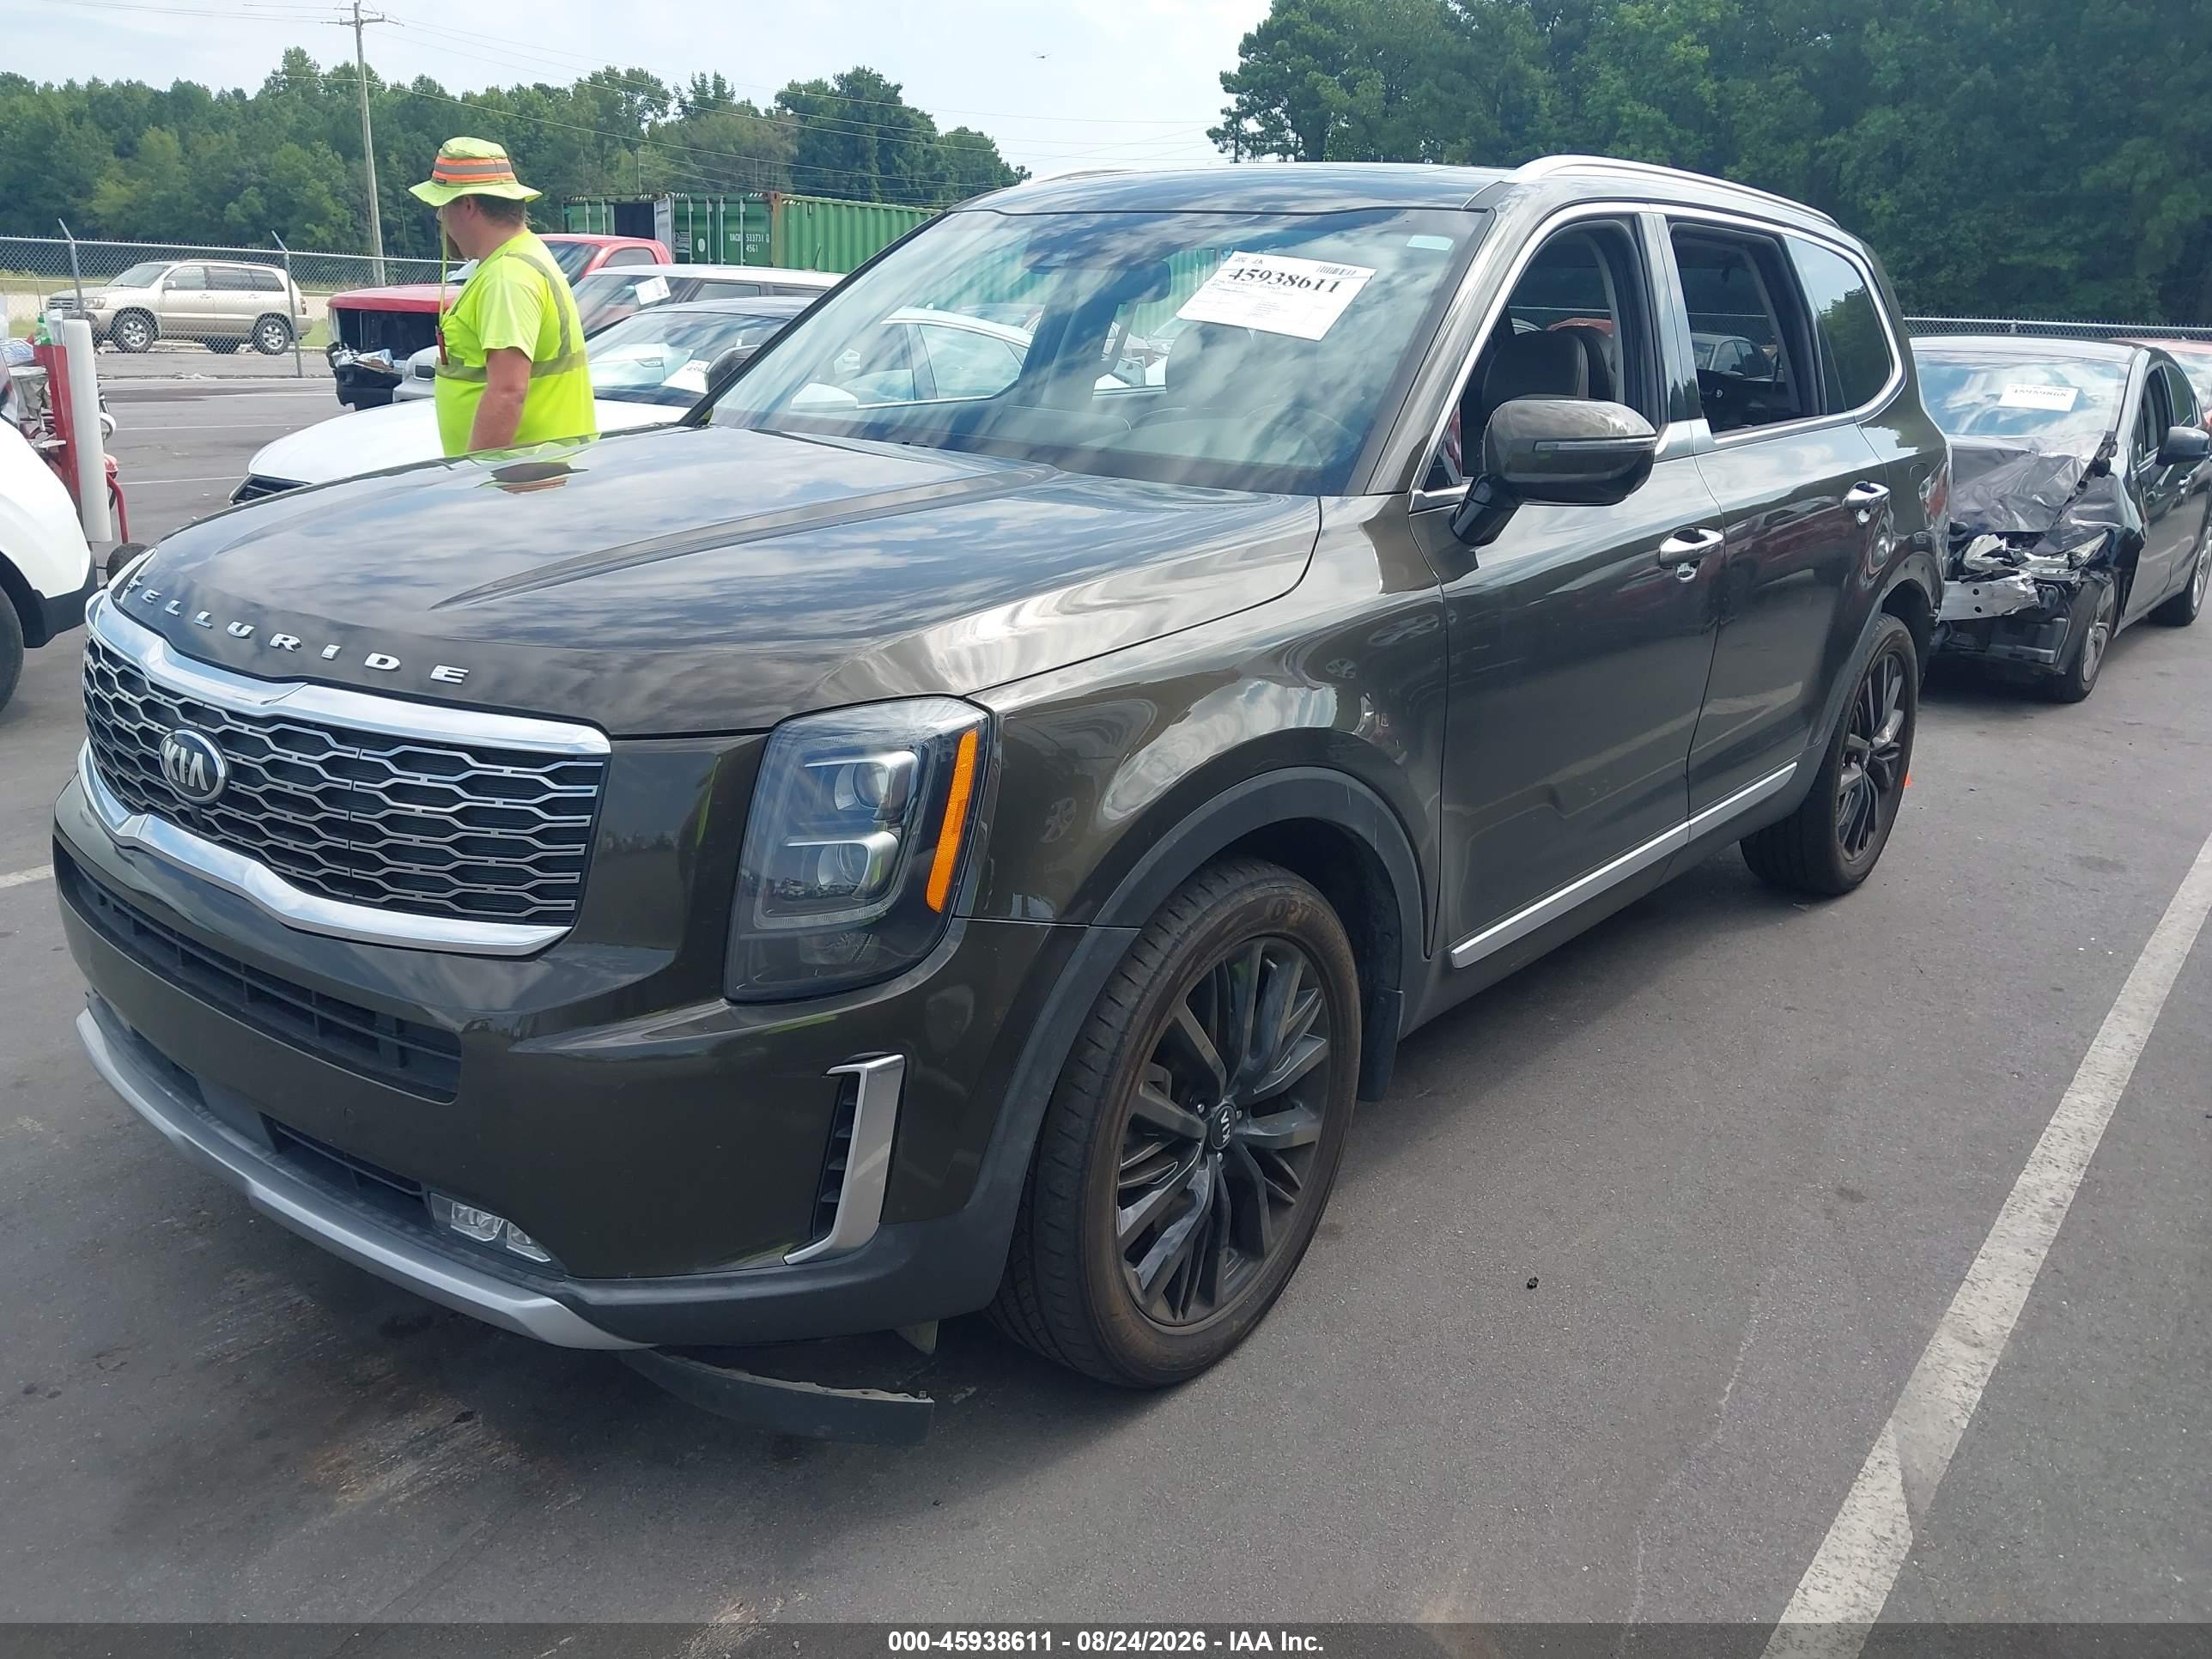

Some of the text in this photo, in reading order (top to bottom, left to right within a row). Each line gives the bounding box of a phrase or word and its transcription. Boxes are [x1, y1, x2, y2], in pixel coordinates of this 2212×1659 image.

[1228, 268, 1341, 293] 45938611
[126, 580, 470, 685] TELLURIDE
[163, 739, 209, 791] KIA
